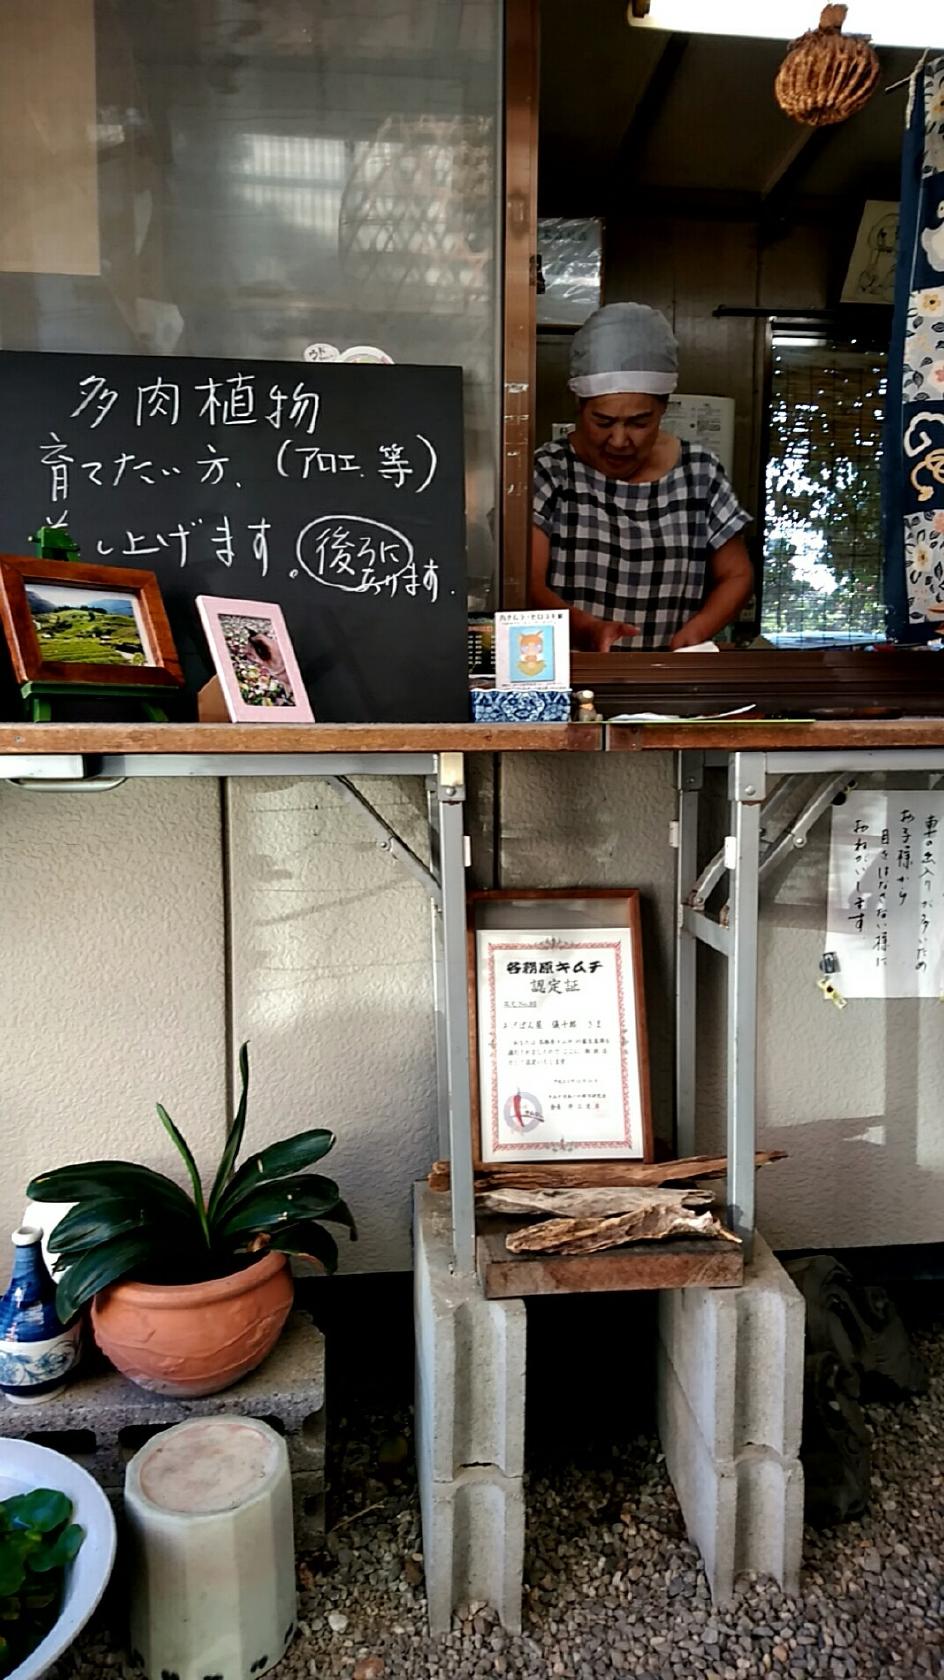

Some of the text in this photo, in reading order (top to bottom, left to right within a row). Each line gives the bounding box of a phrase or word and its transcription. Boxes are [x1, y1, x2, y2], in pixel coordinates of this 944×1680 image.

[70, 372, 320, 434] 多肉植物
[848, 820, 869, 932] おねがいします
[530, 979, 581, 995] 認定証
